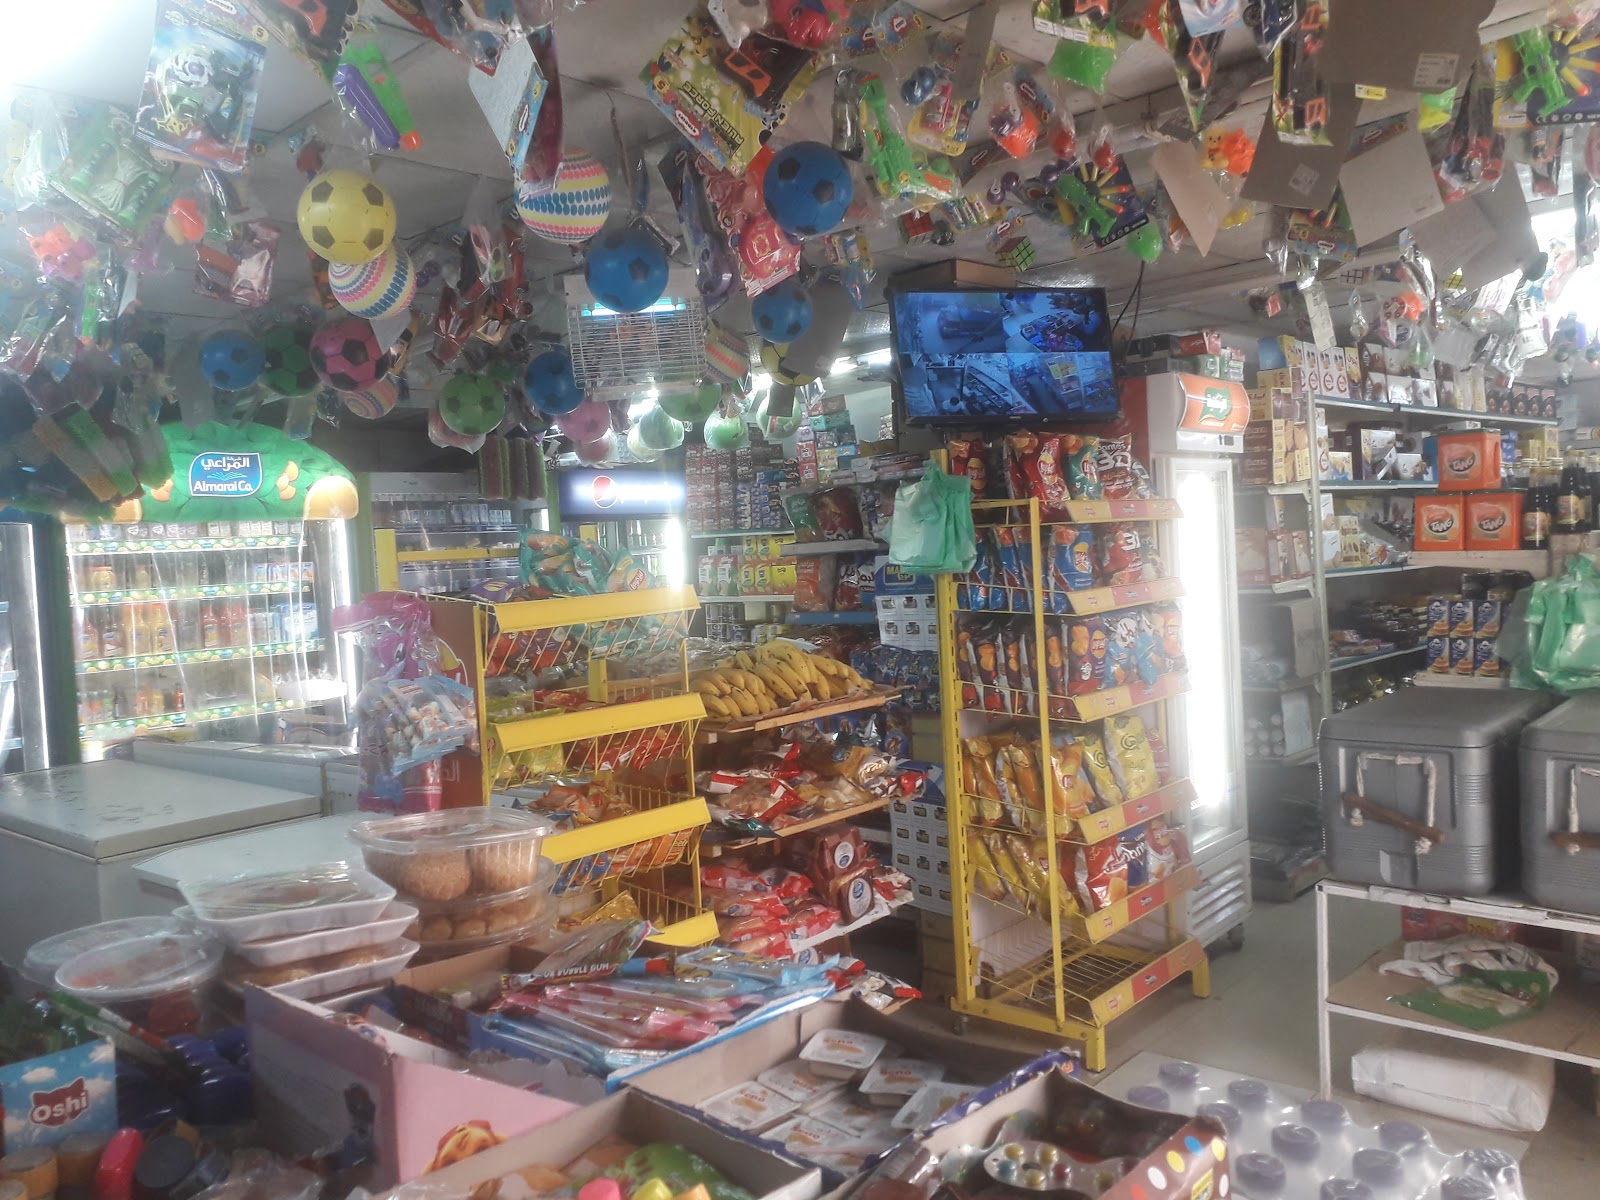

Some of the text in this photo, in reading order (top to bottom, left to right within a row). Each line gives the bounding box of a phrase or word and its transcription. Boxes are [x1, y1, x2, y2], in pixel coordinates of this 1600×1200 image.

[681, 80, 745, 146] ALIEN FORCE
[200, 456, 251, 472] المراعي
[1451, 455, 1474, 471] TANG
[193, 480, 238, 492] Almarai
[1429, 517, 1454, 532] TANG
[1481, 516, 1504, 531] TANG
[557, 964, 588, 976] BUBBLE
[590, 962, 610, 972] GUM
[31, 1091, 87, 1123] Oshi
